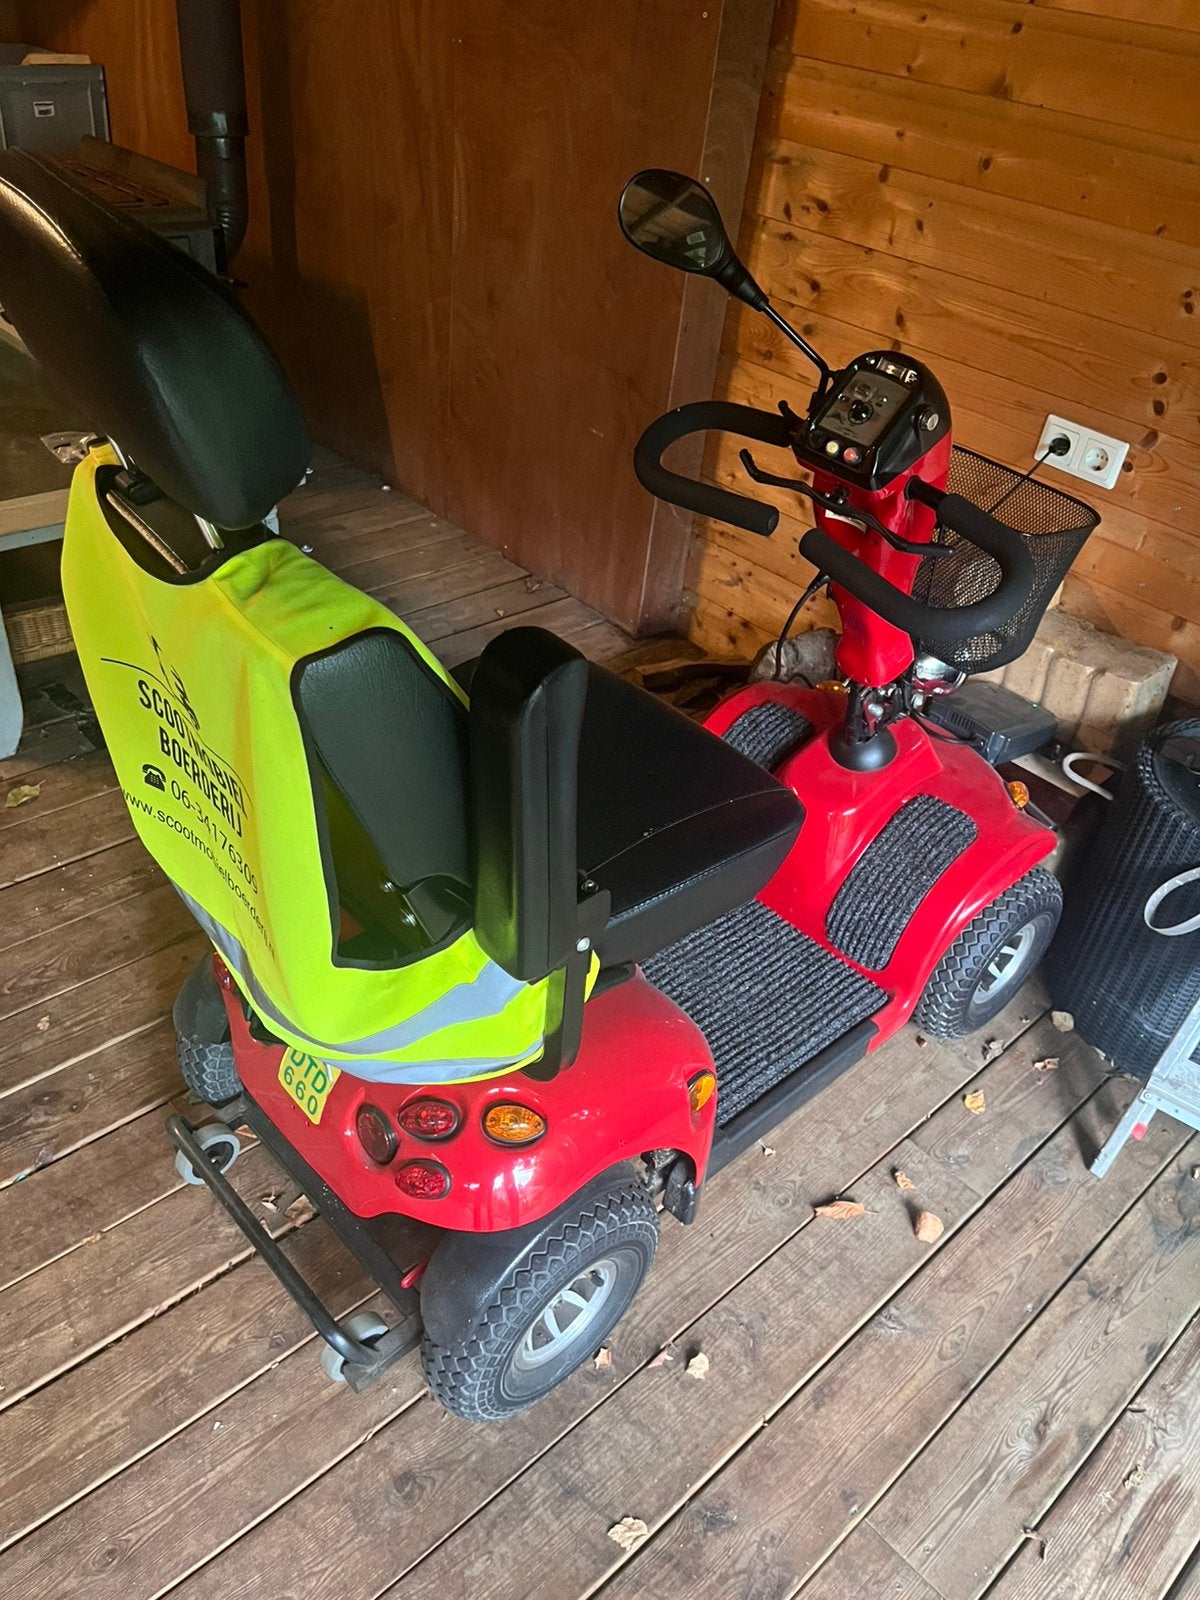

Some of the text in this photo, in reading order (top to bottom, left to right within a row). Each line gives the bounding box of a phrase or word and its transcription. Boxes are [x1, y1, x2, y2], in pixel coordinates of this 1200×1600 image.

[158, 725, 243, 838] BOERDERIJ
[171, 779, 259, 894] 06-34176309
[283, 1065, 318, 1116] 660
